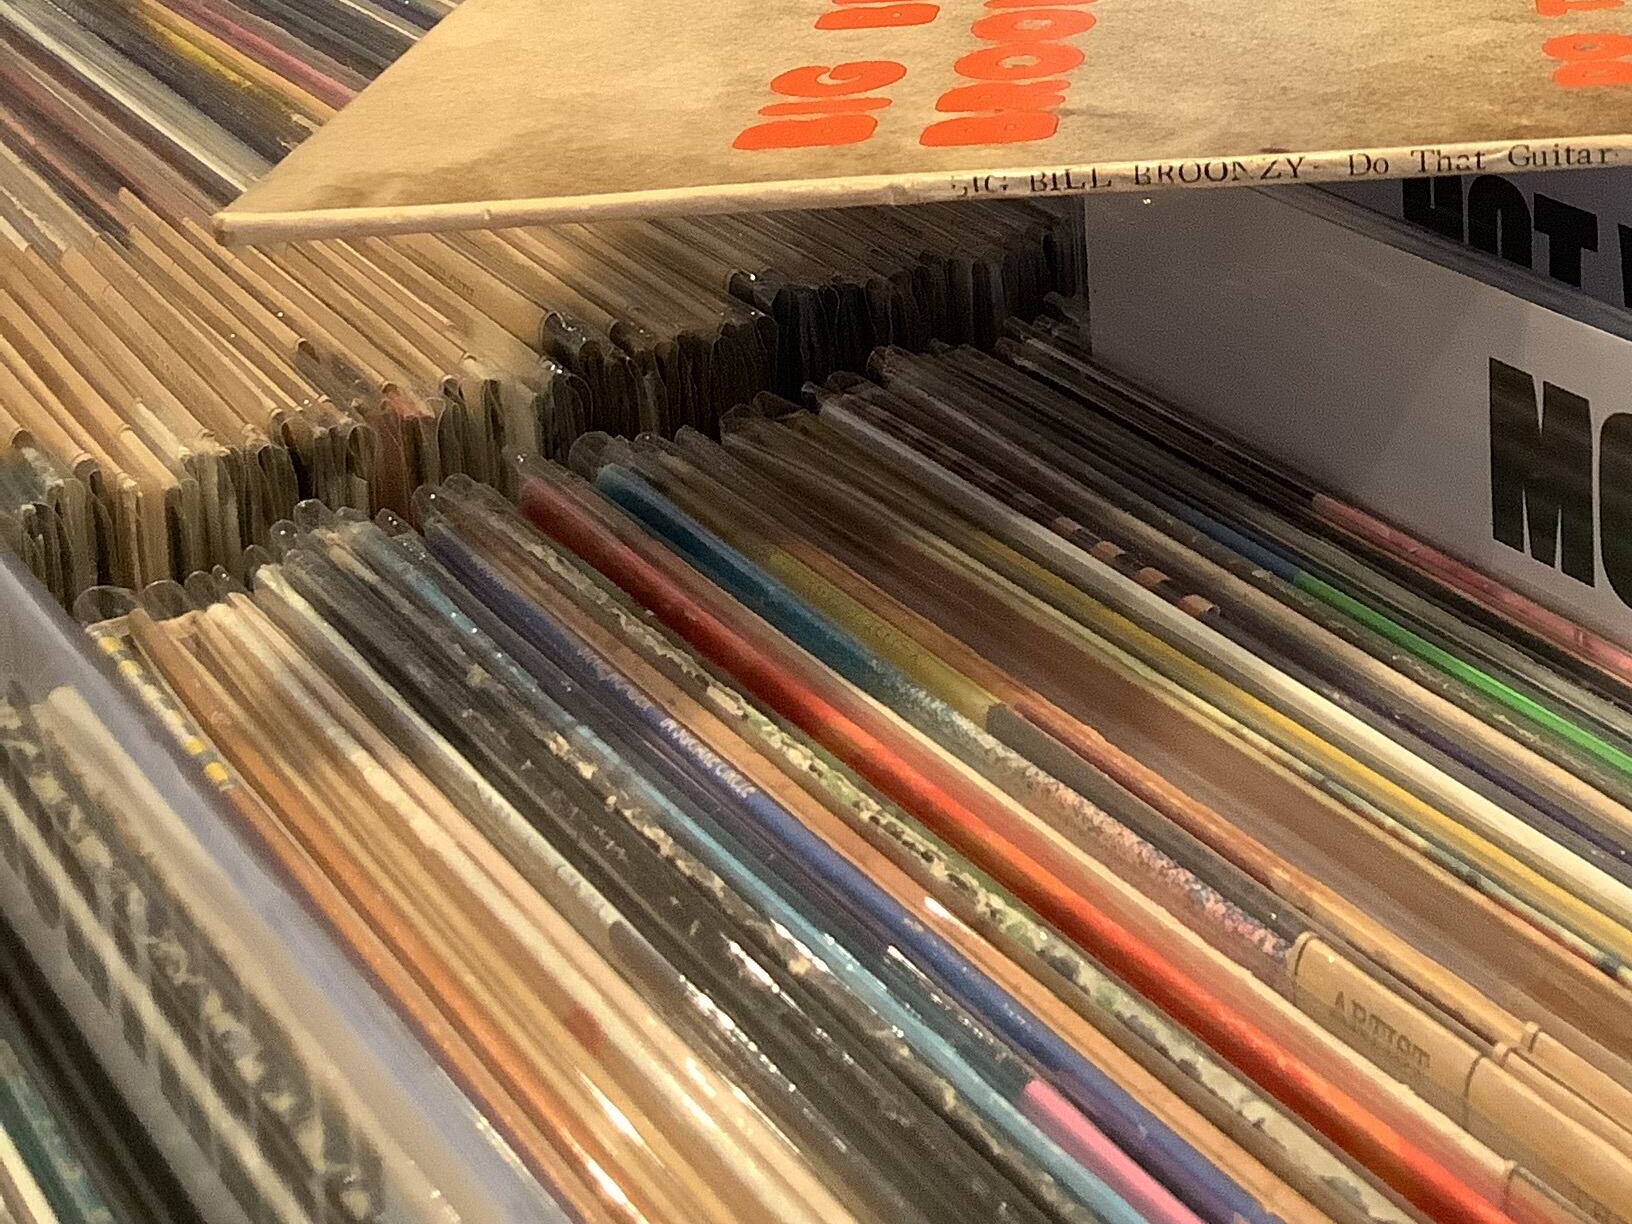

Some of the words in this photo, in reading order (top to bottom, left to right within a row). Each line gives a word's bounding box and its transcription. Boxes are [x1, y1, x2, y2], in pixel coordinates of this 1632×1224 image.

[732, 60, 907, 151] BIG
[1348, 152, 1390, 176] Do
[1411, 149, 1487, 174] That
[1507, 142, 1615, 170] Guitar
